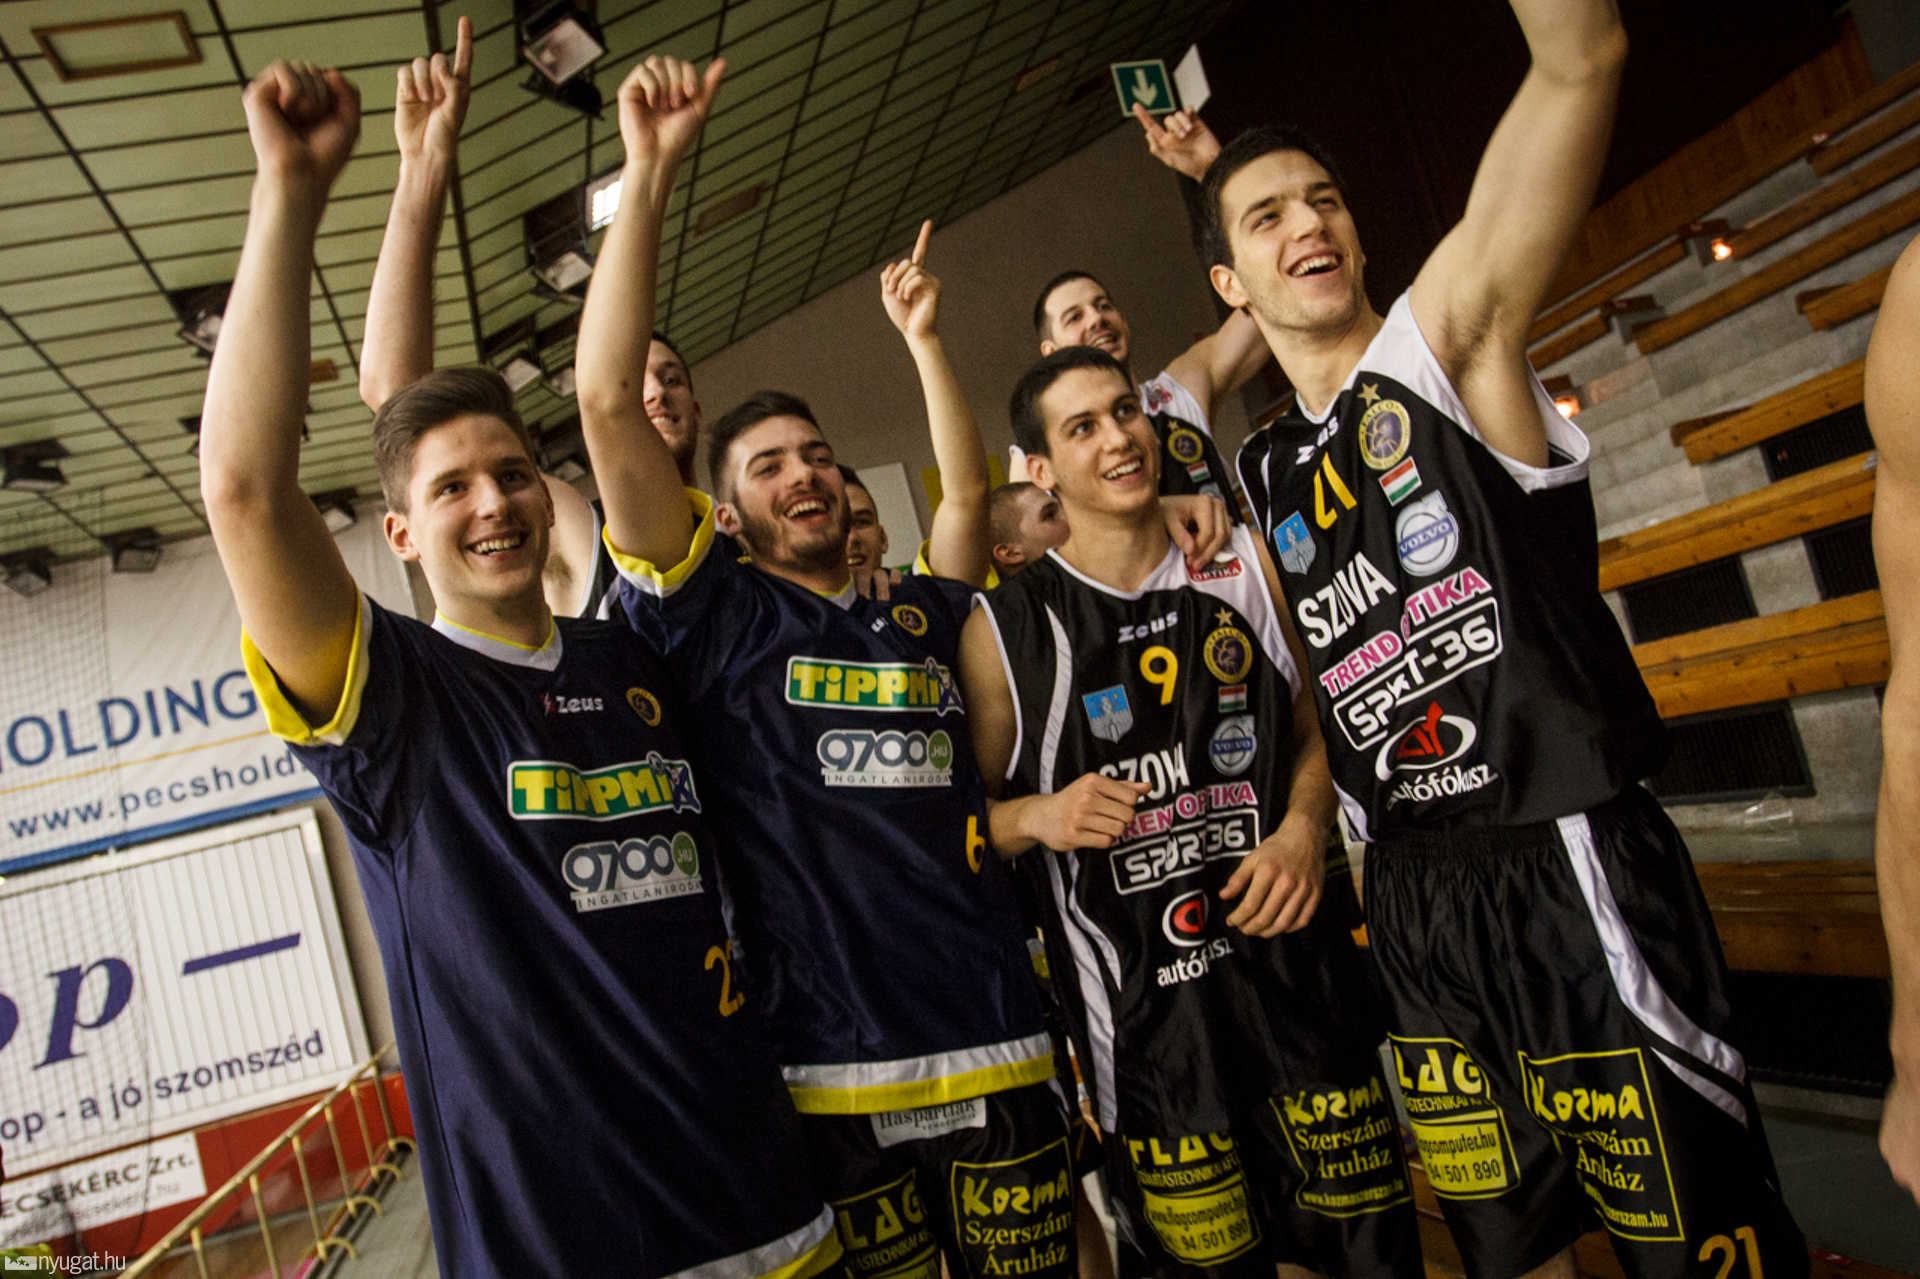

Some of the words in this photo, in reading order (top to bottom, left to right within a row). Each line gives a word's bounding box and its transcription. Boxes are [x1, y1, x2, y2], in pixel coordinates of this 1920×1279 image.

[1400, 519, 1450, 553] VOLVO
[1117, 610, 1179, 644] Zeus
[1320, 631, 1401, 698] TREND
[1400, 567, 1492, 640] TIKA
[1139, 645, 1178, 705] 9
[0, 669, 257, 774] OLDING
[556, 695, 604, 714] Zeus
[1214, 738, 1252, 752] VOLVO
[9, 748, 309, 840] www.pecshold
[80, 1096, 100, 1121] a
[111, 1079, 143, 1121] jó
[154, 1030, 324, 1101] szomszéd
[1527, 1066, 1645, 1123] Kozma
[1295, 1116, 1393, 1151] Szerszám
[1473, 1158, 1501, 1182] 890
[961, 1168, 1070, 1217] Kozma
[965, 1211, 1072, 1246] Szerszám
[983, 1242, 1070, 1277] Áruház
